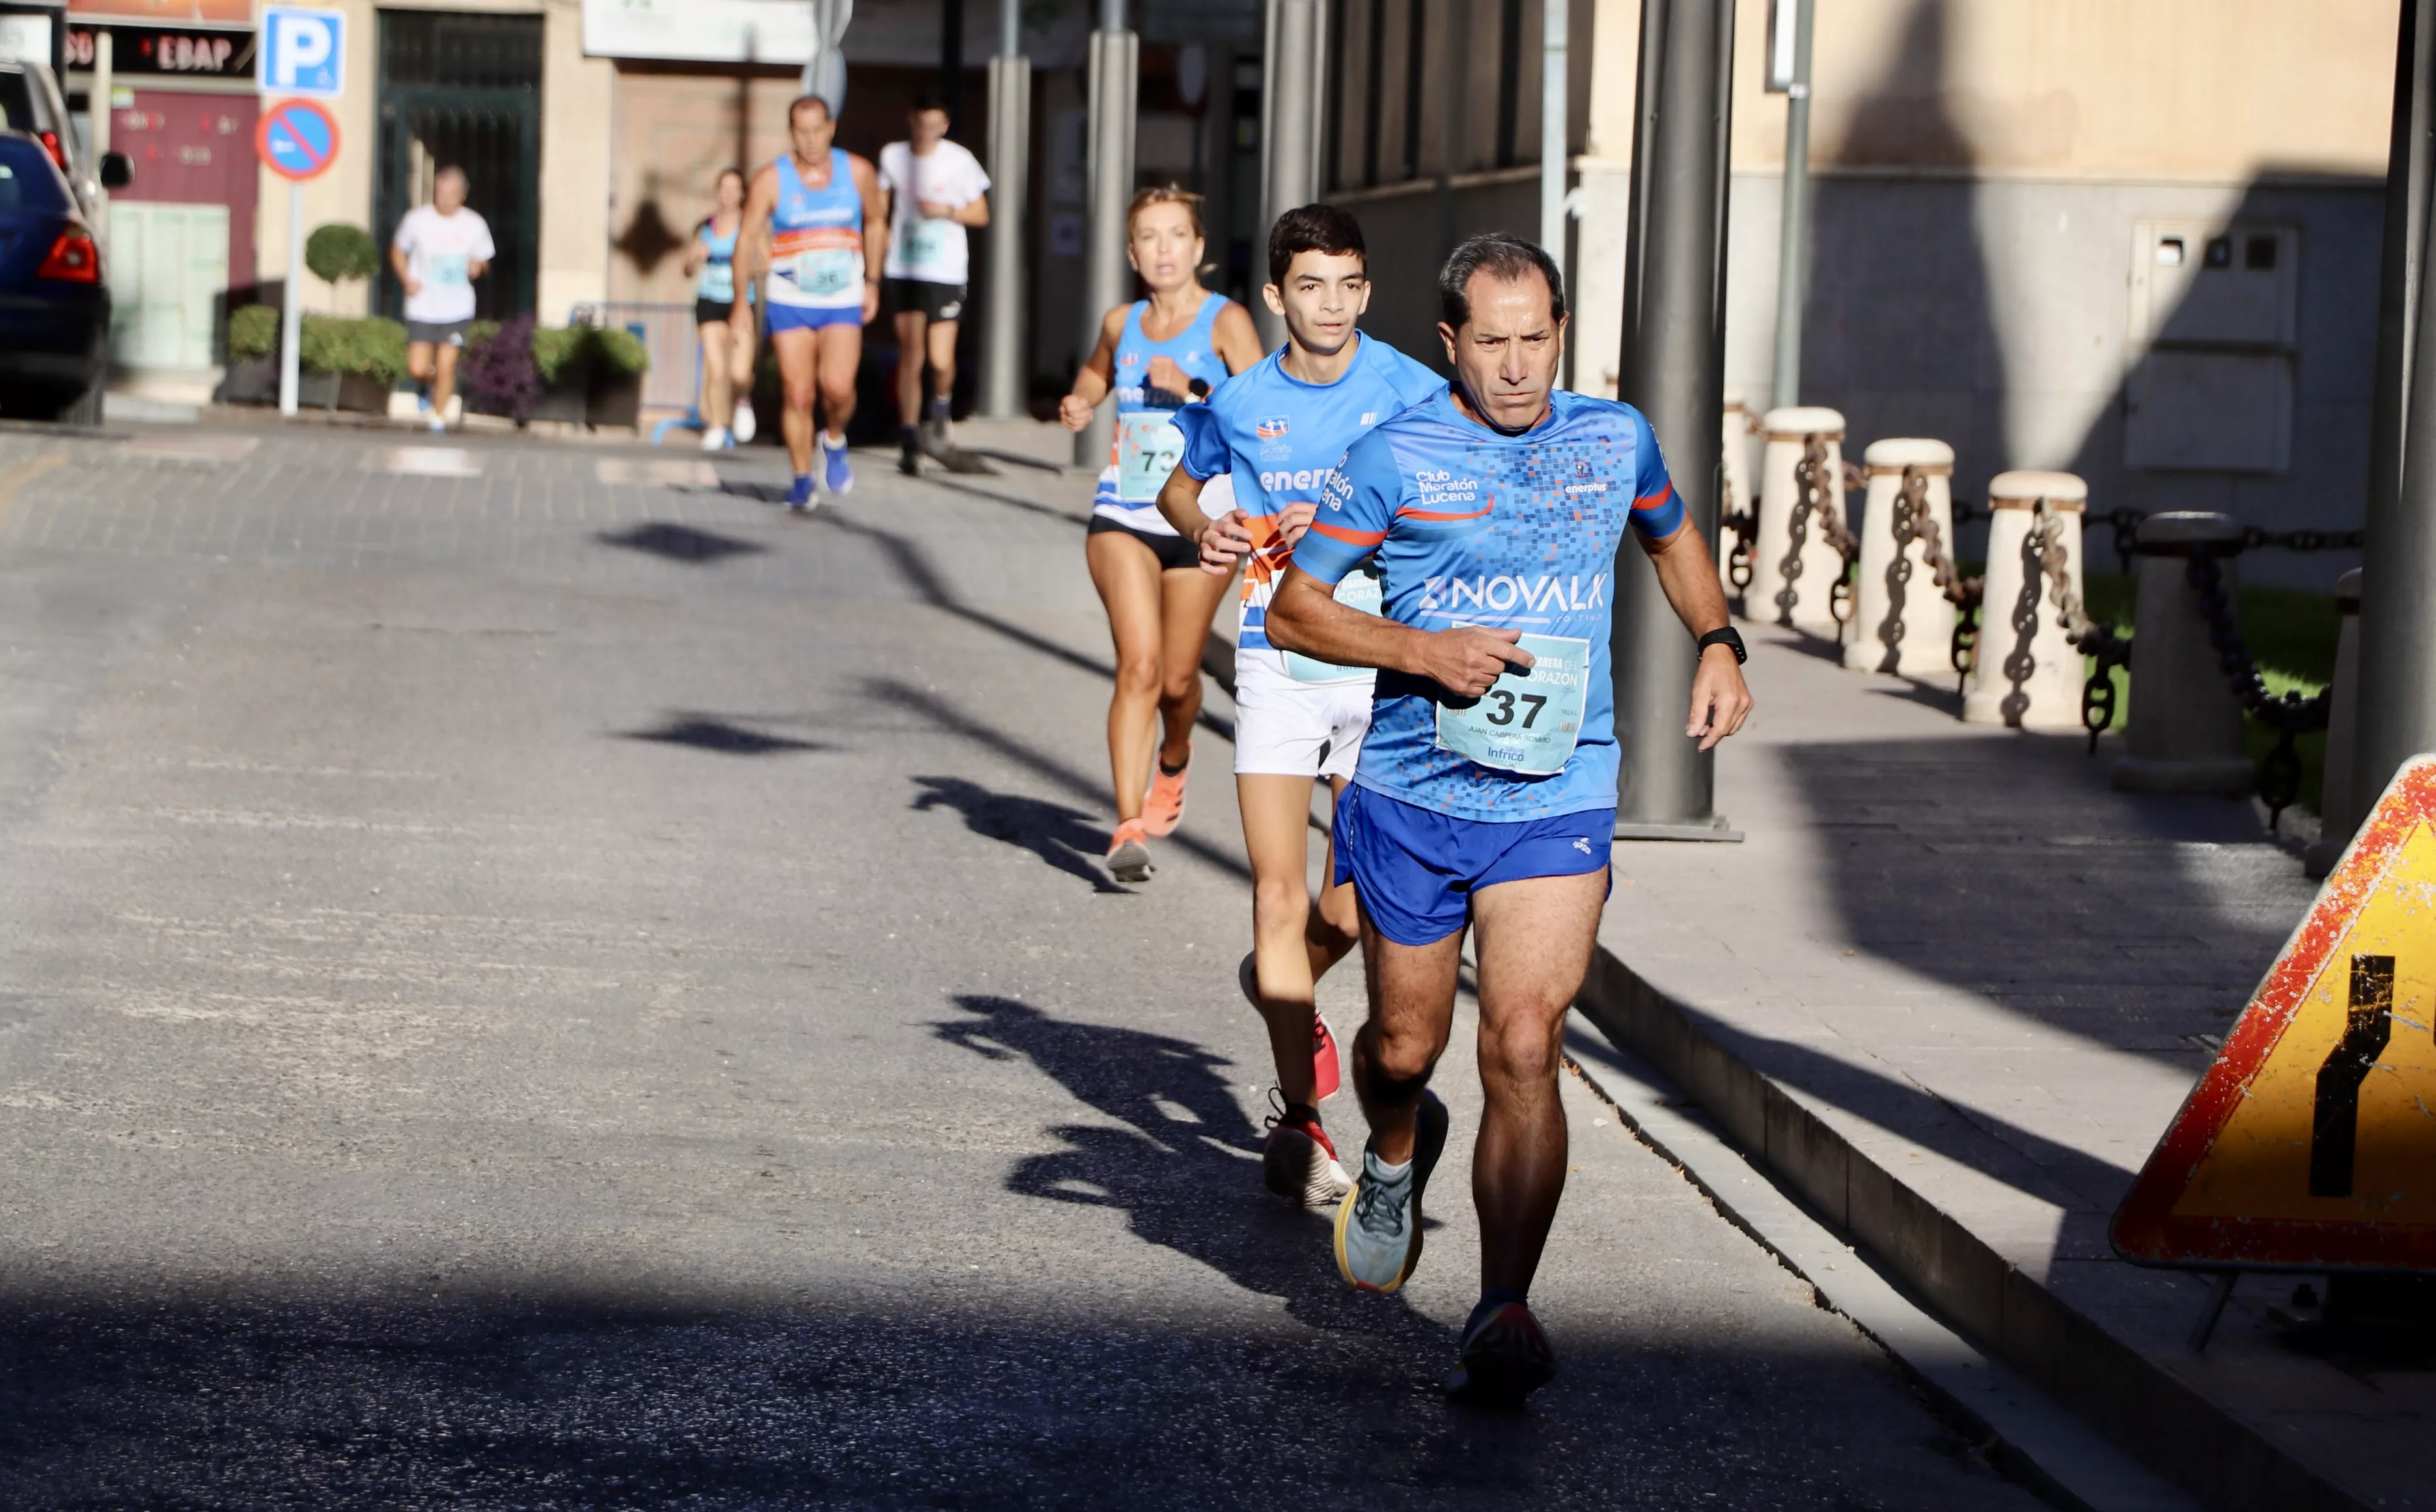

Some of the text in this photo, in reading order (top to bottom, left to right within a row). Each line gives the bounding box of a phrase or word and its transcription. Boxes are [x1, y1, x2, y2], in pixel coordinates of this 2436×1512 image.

[1415, 470, 1450, 482] Club
[1418, 478, 1478, 493] Maratón
[1564, 482, 1607, 493] enerplus
[1421, 490, 1476, 505] Lucena
[1452, 572, 1607, 612] NOVALK
[1565, 660, 1578, 671] DEL
[1486, 690, 1547, 729] 37
[1468, 726, 1488, 735] JUAN
[1488, 747, 1524, 762] Infrico
